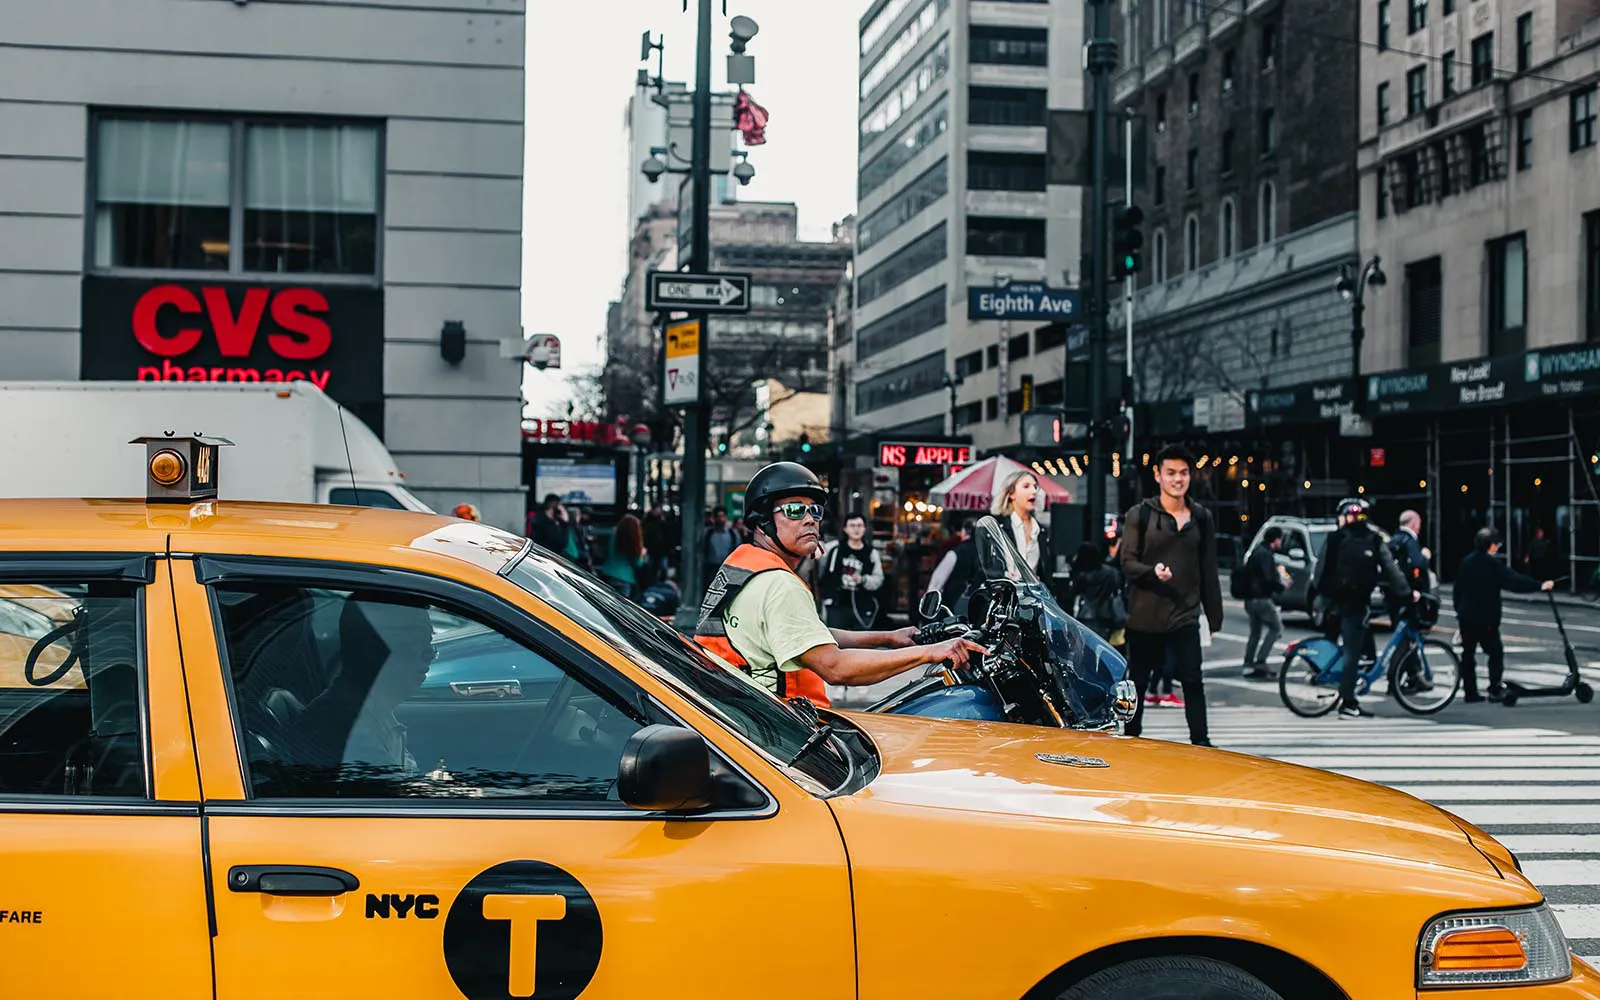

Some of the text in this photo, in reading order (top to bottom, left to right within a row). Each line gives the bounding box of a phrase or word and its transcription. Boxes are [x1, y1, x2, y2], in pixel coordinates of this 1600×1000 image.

[667, 284, 731, 298] ONE WAY
[980, 293, 1073, 316] Eighth Ave
[132, 284, 332, 359] CVS
[882, 444, 970, 467] NS APPLE
[0, 910, 43, 924] FARE
[365, 893, 566, 997] NYC T
